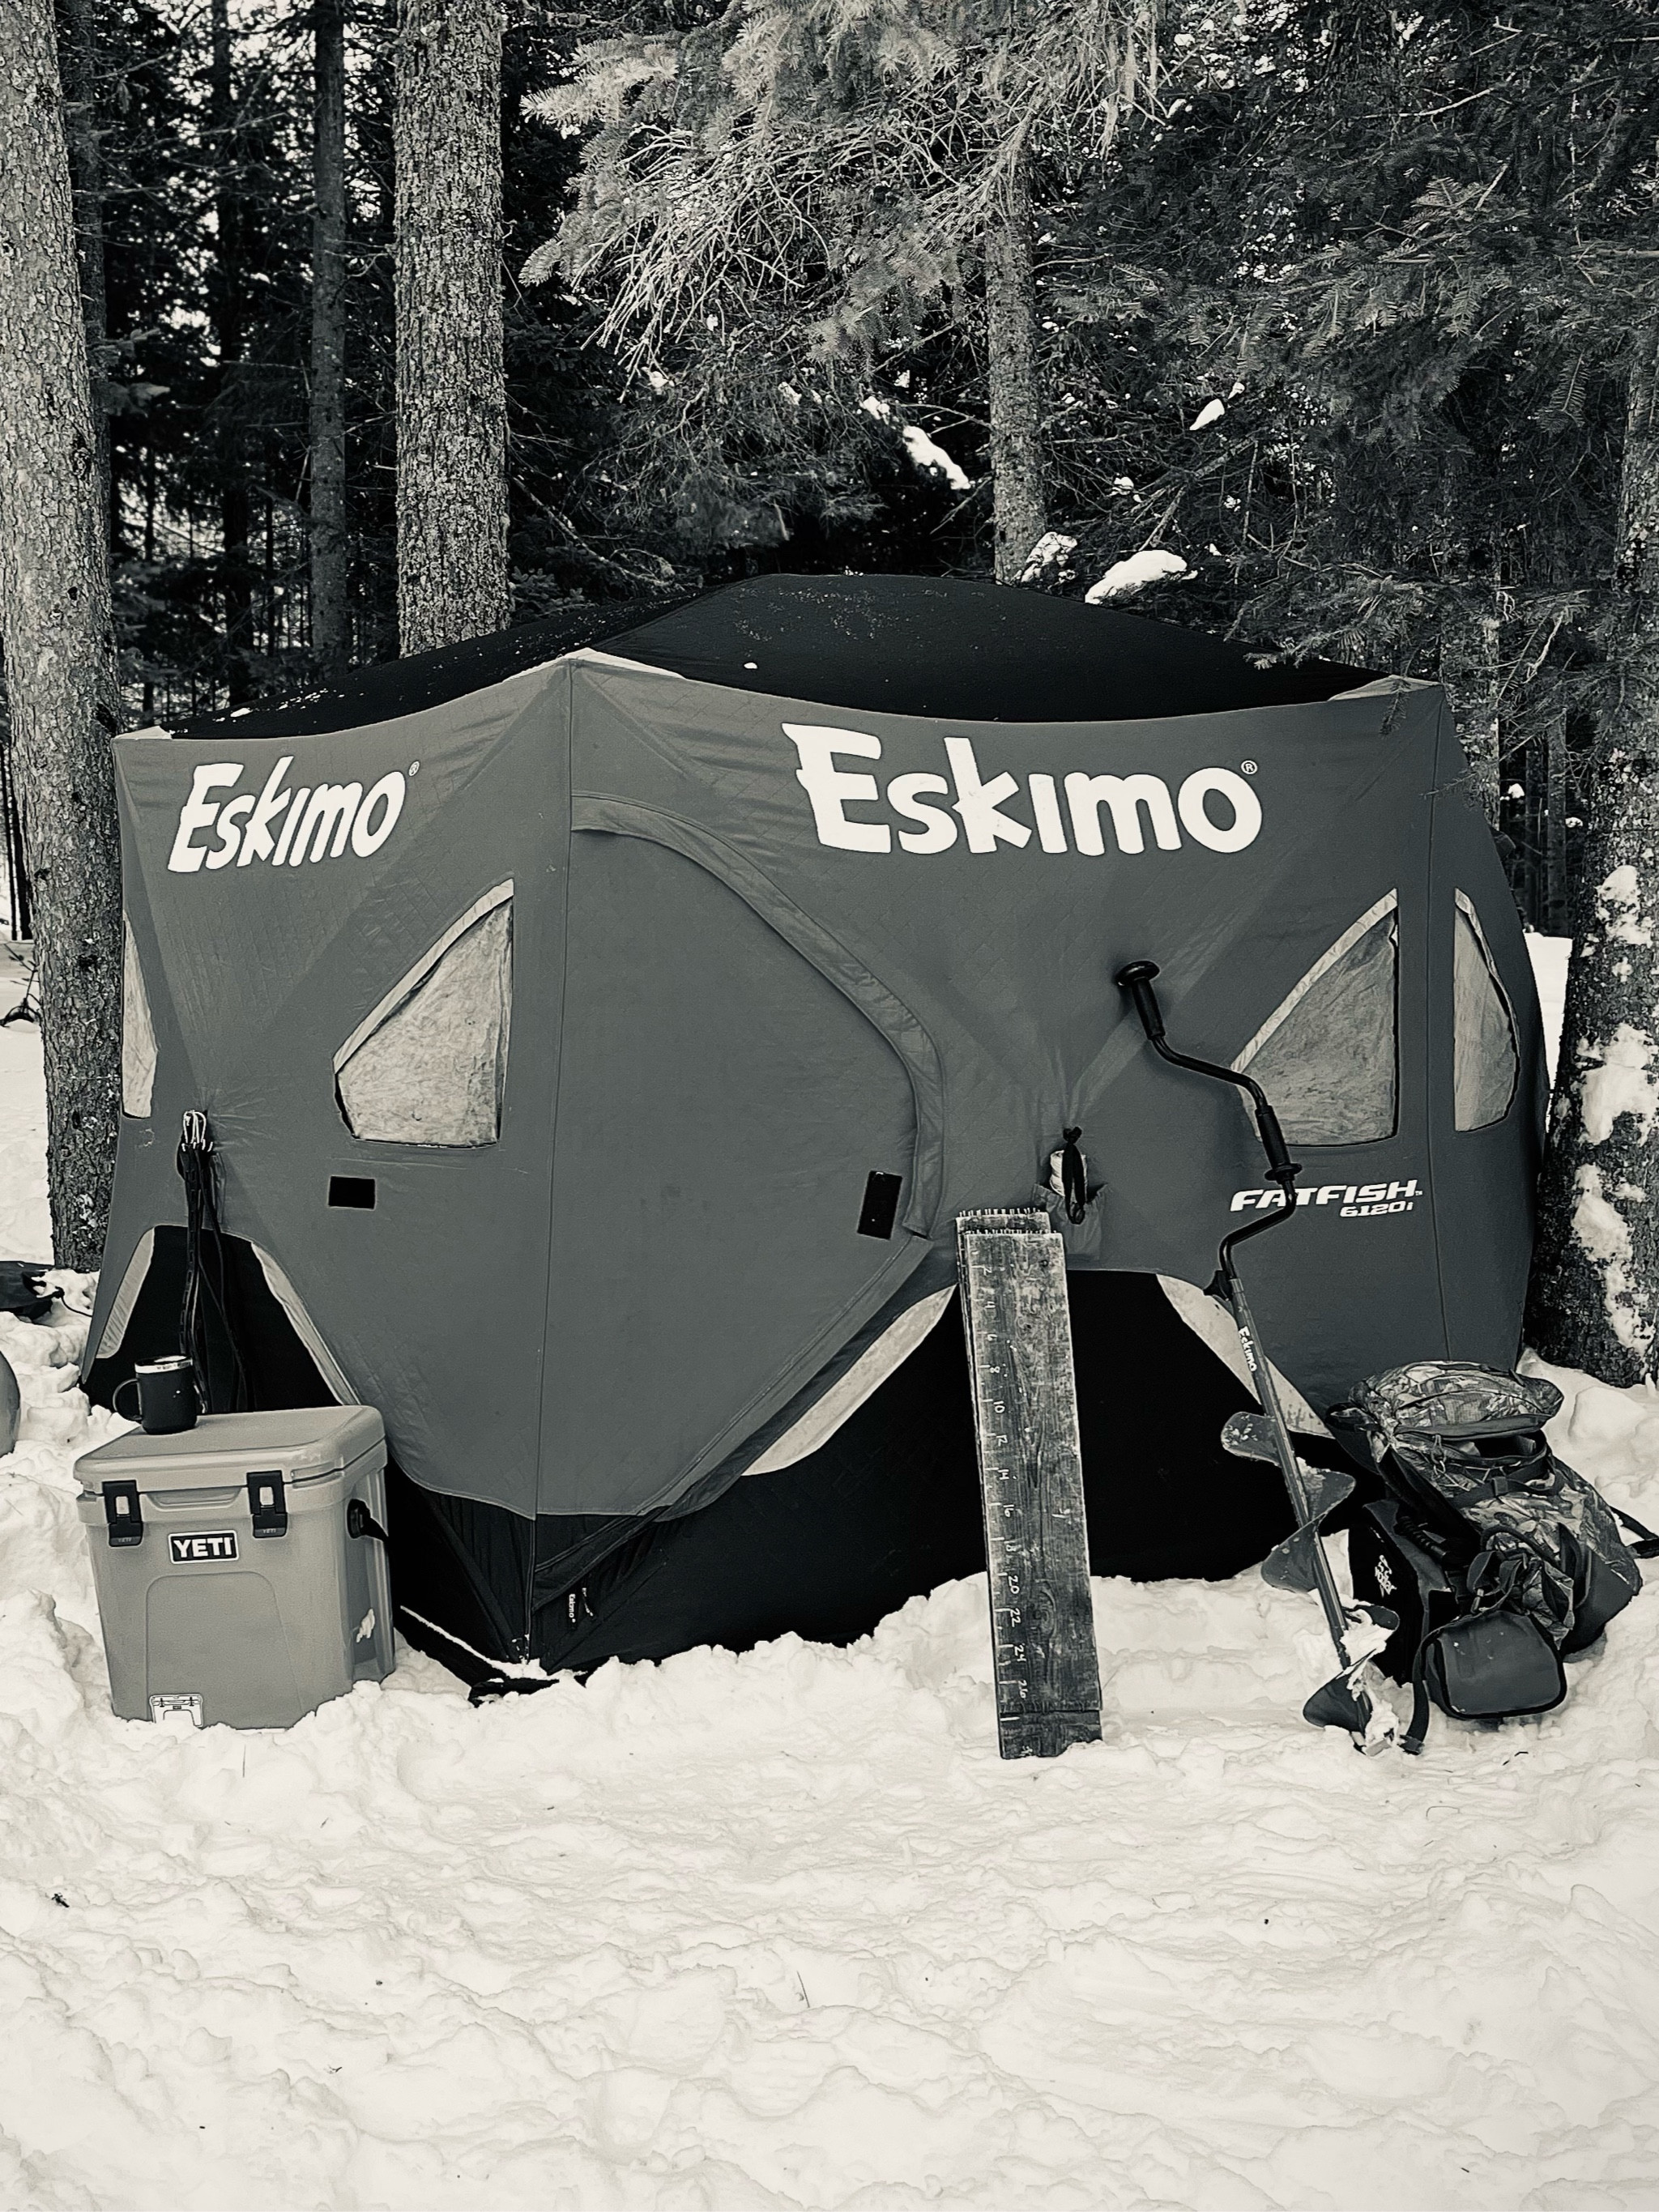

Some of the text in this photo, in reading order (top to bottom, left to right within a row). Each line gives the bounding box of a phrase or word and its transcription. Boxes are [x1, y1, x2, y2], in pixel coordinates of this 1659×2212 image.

[1230, 1179, 1418, 1212] FATFISH
[989, 1366, 1000, 1374] 8
[993, 1400, 1005, 1414] 10
[998, 1468, 1010, 1481] 14
[1003, 1504, 1015, 1519] 16
[173, 1536, 232, 1558] YETI
[1008, 1575, 1021, 1595] 20
[1009, 1608, 1021, 1628] 22
[1014, 1643, 1026, 1662] 24
[1017, 1679, 1029, 1698] 26
